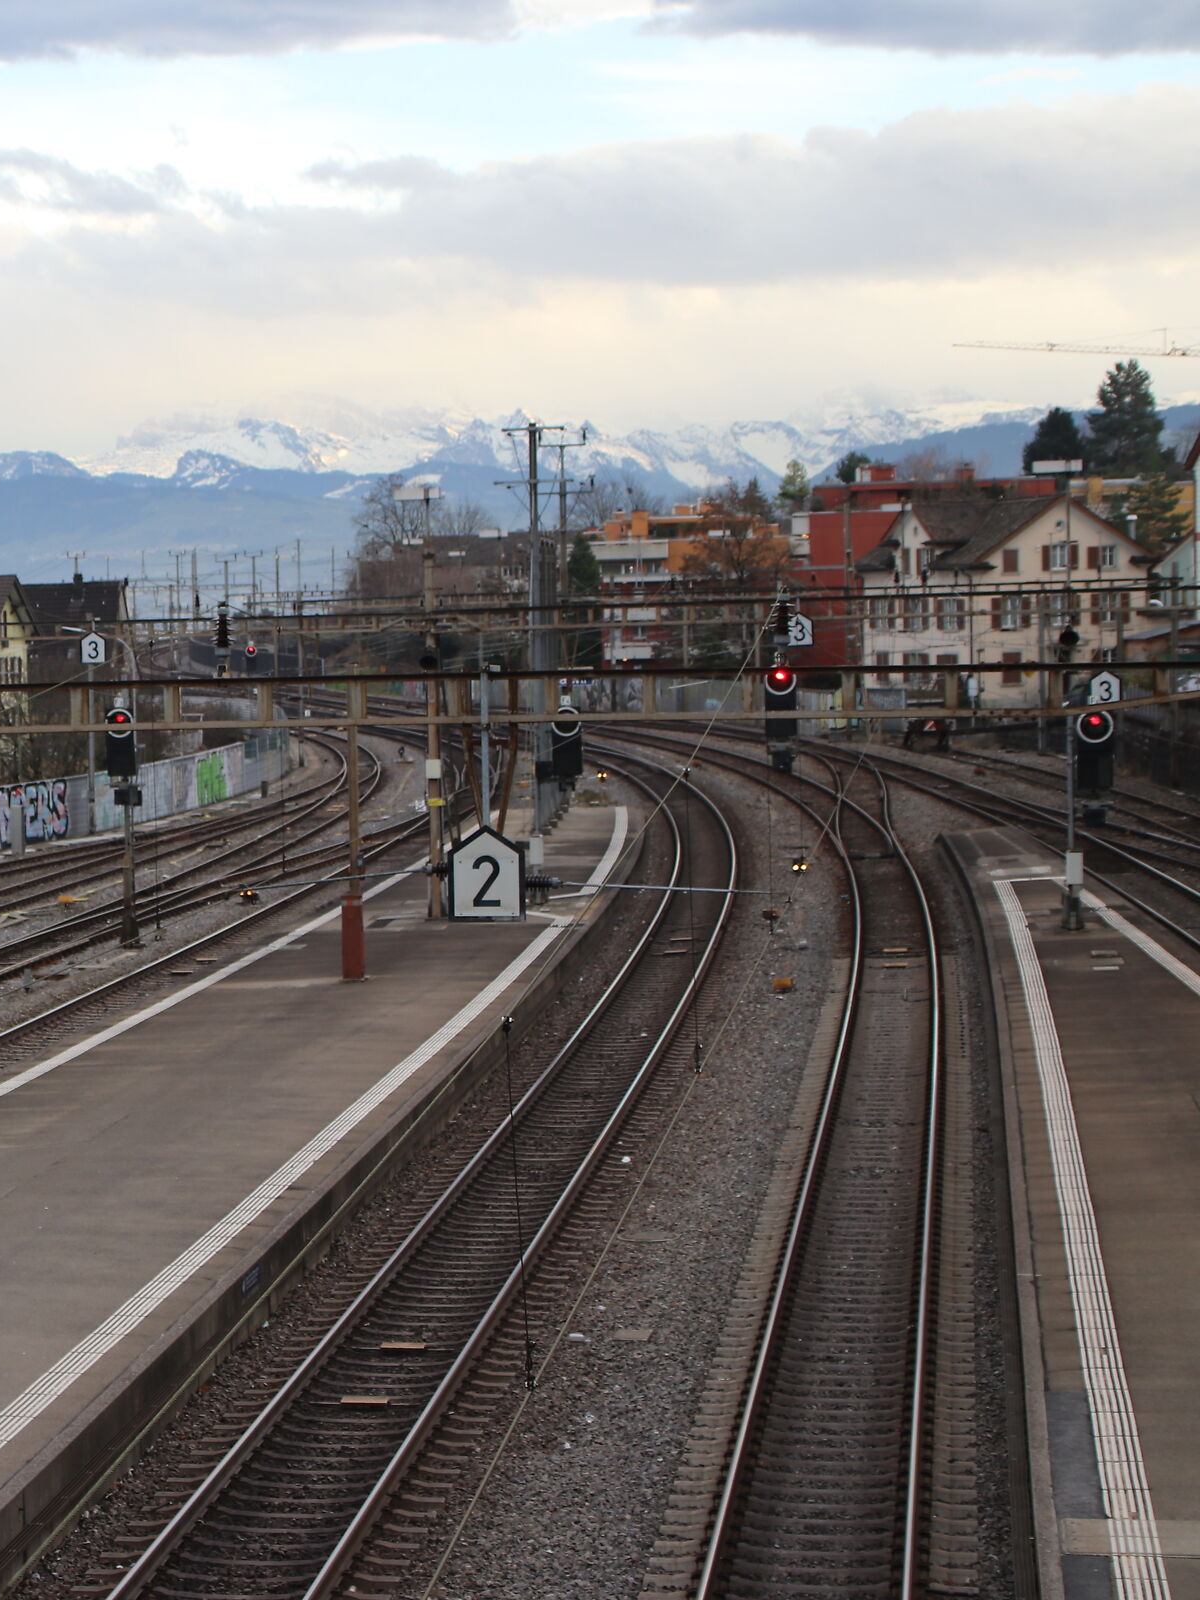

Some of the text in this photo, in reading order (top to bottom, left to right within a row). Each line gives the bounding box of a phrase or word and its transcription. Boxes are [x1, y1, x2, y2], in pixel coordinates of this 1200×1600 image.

[793, 621, 806, 641] 3
[88, 641, 99, 659] 3
[1100, 681, 1112, 701] 3
[472, 855, 501, 907] 2
